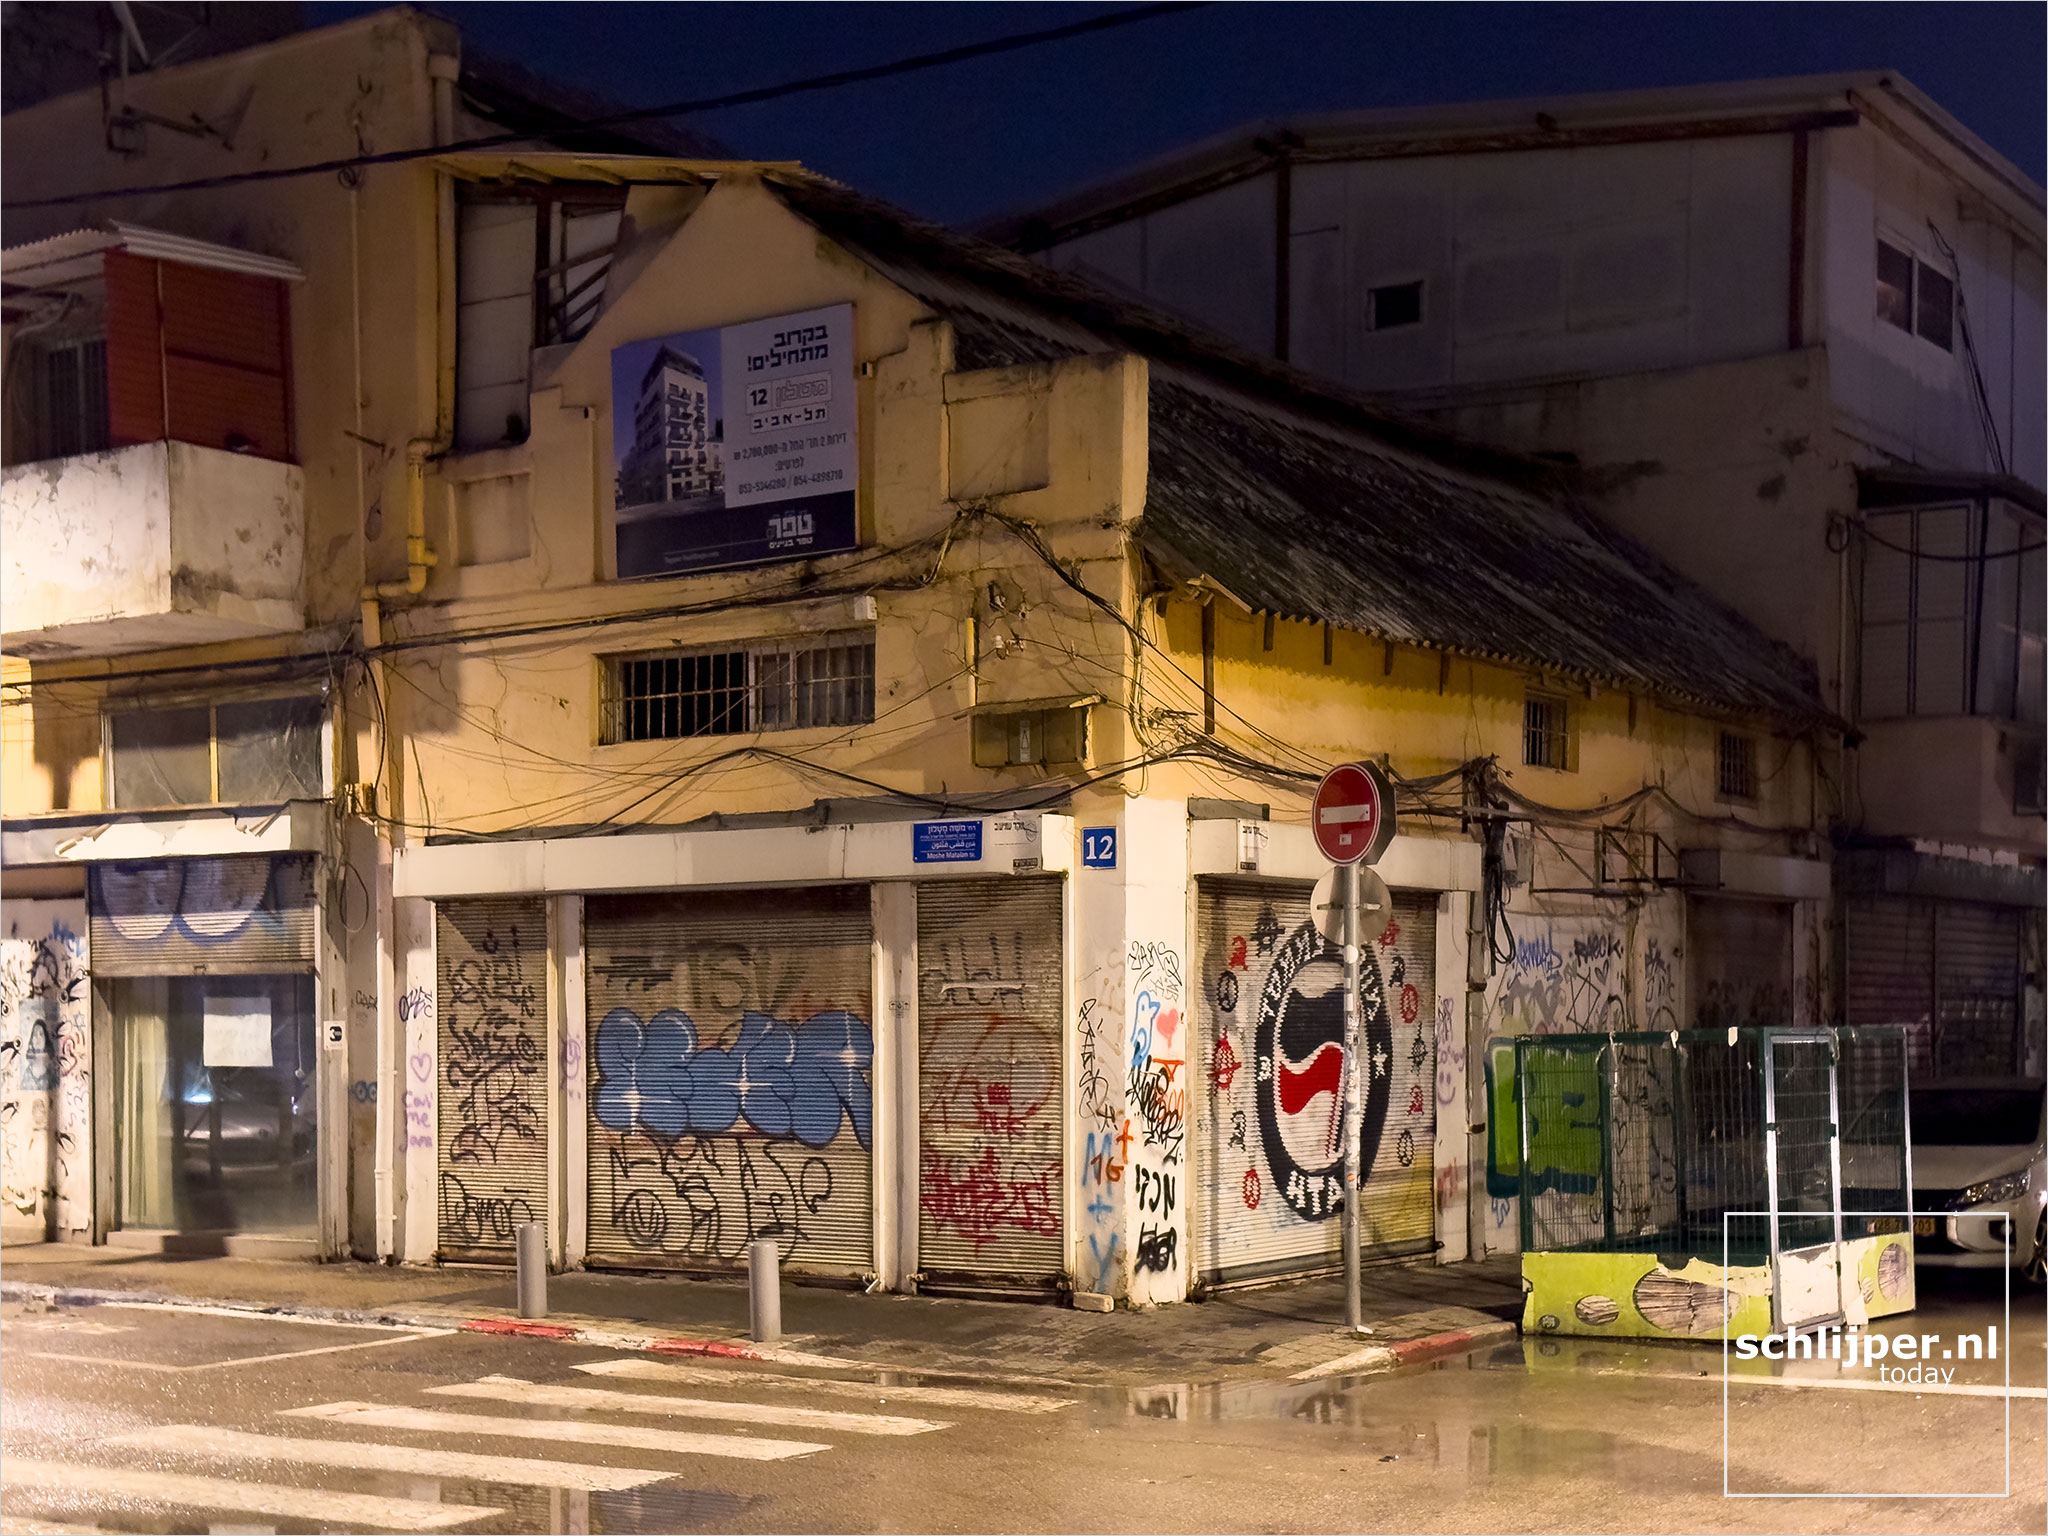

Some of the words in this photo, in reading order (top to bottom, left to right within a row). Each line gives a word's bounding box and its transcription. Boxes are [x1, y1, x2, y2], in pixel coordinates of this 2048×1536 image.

[774, 325, 828, 347] בקרוב
[747, 344, 828, 371] מתחילים!
[750, 388, 768, 406] 12
[753, 408, 826, 429] תל-אביב
[1086, 835, 1113, 860] 12
